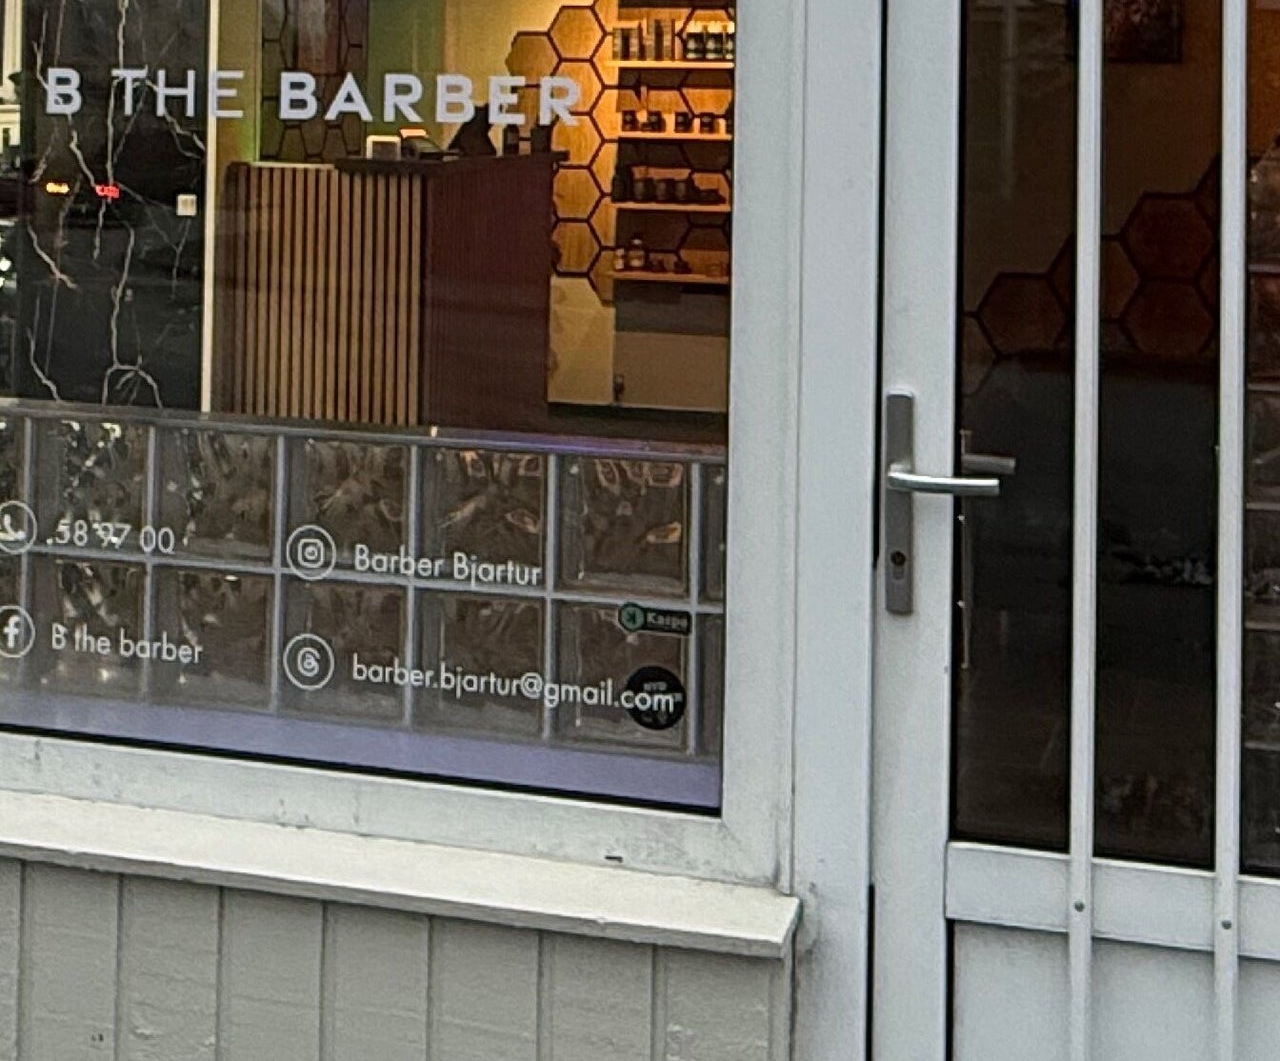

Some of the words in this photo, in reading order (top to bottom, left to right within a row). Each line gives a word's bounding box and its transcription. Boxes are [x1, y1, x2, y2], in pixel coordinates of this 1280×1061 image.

[45, 67, 82, 115] B
[112, 69, 245, 119] THE
[279, 72, 581, 127] BARBER
[139, 524, 176, 555] 00
[354, 543, 445, 578] Barber
[453, 551, 542, 588] Bjartur
[51, 622, 68, 651] B
[74, 622, 111, 655] the
[119, 626, 204, 664] barber
[352, 652, 674, 714] barber.bjartur@gmail.com
